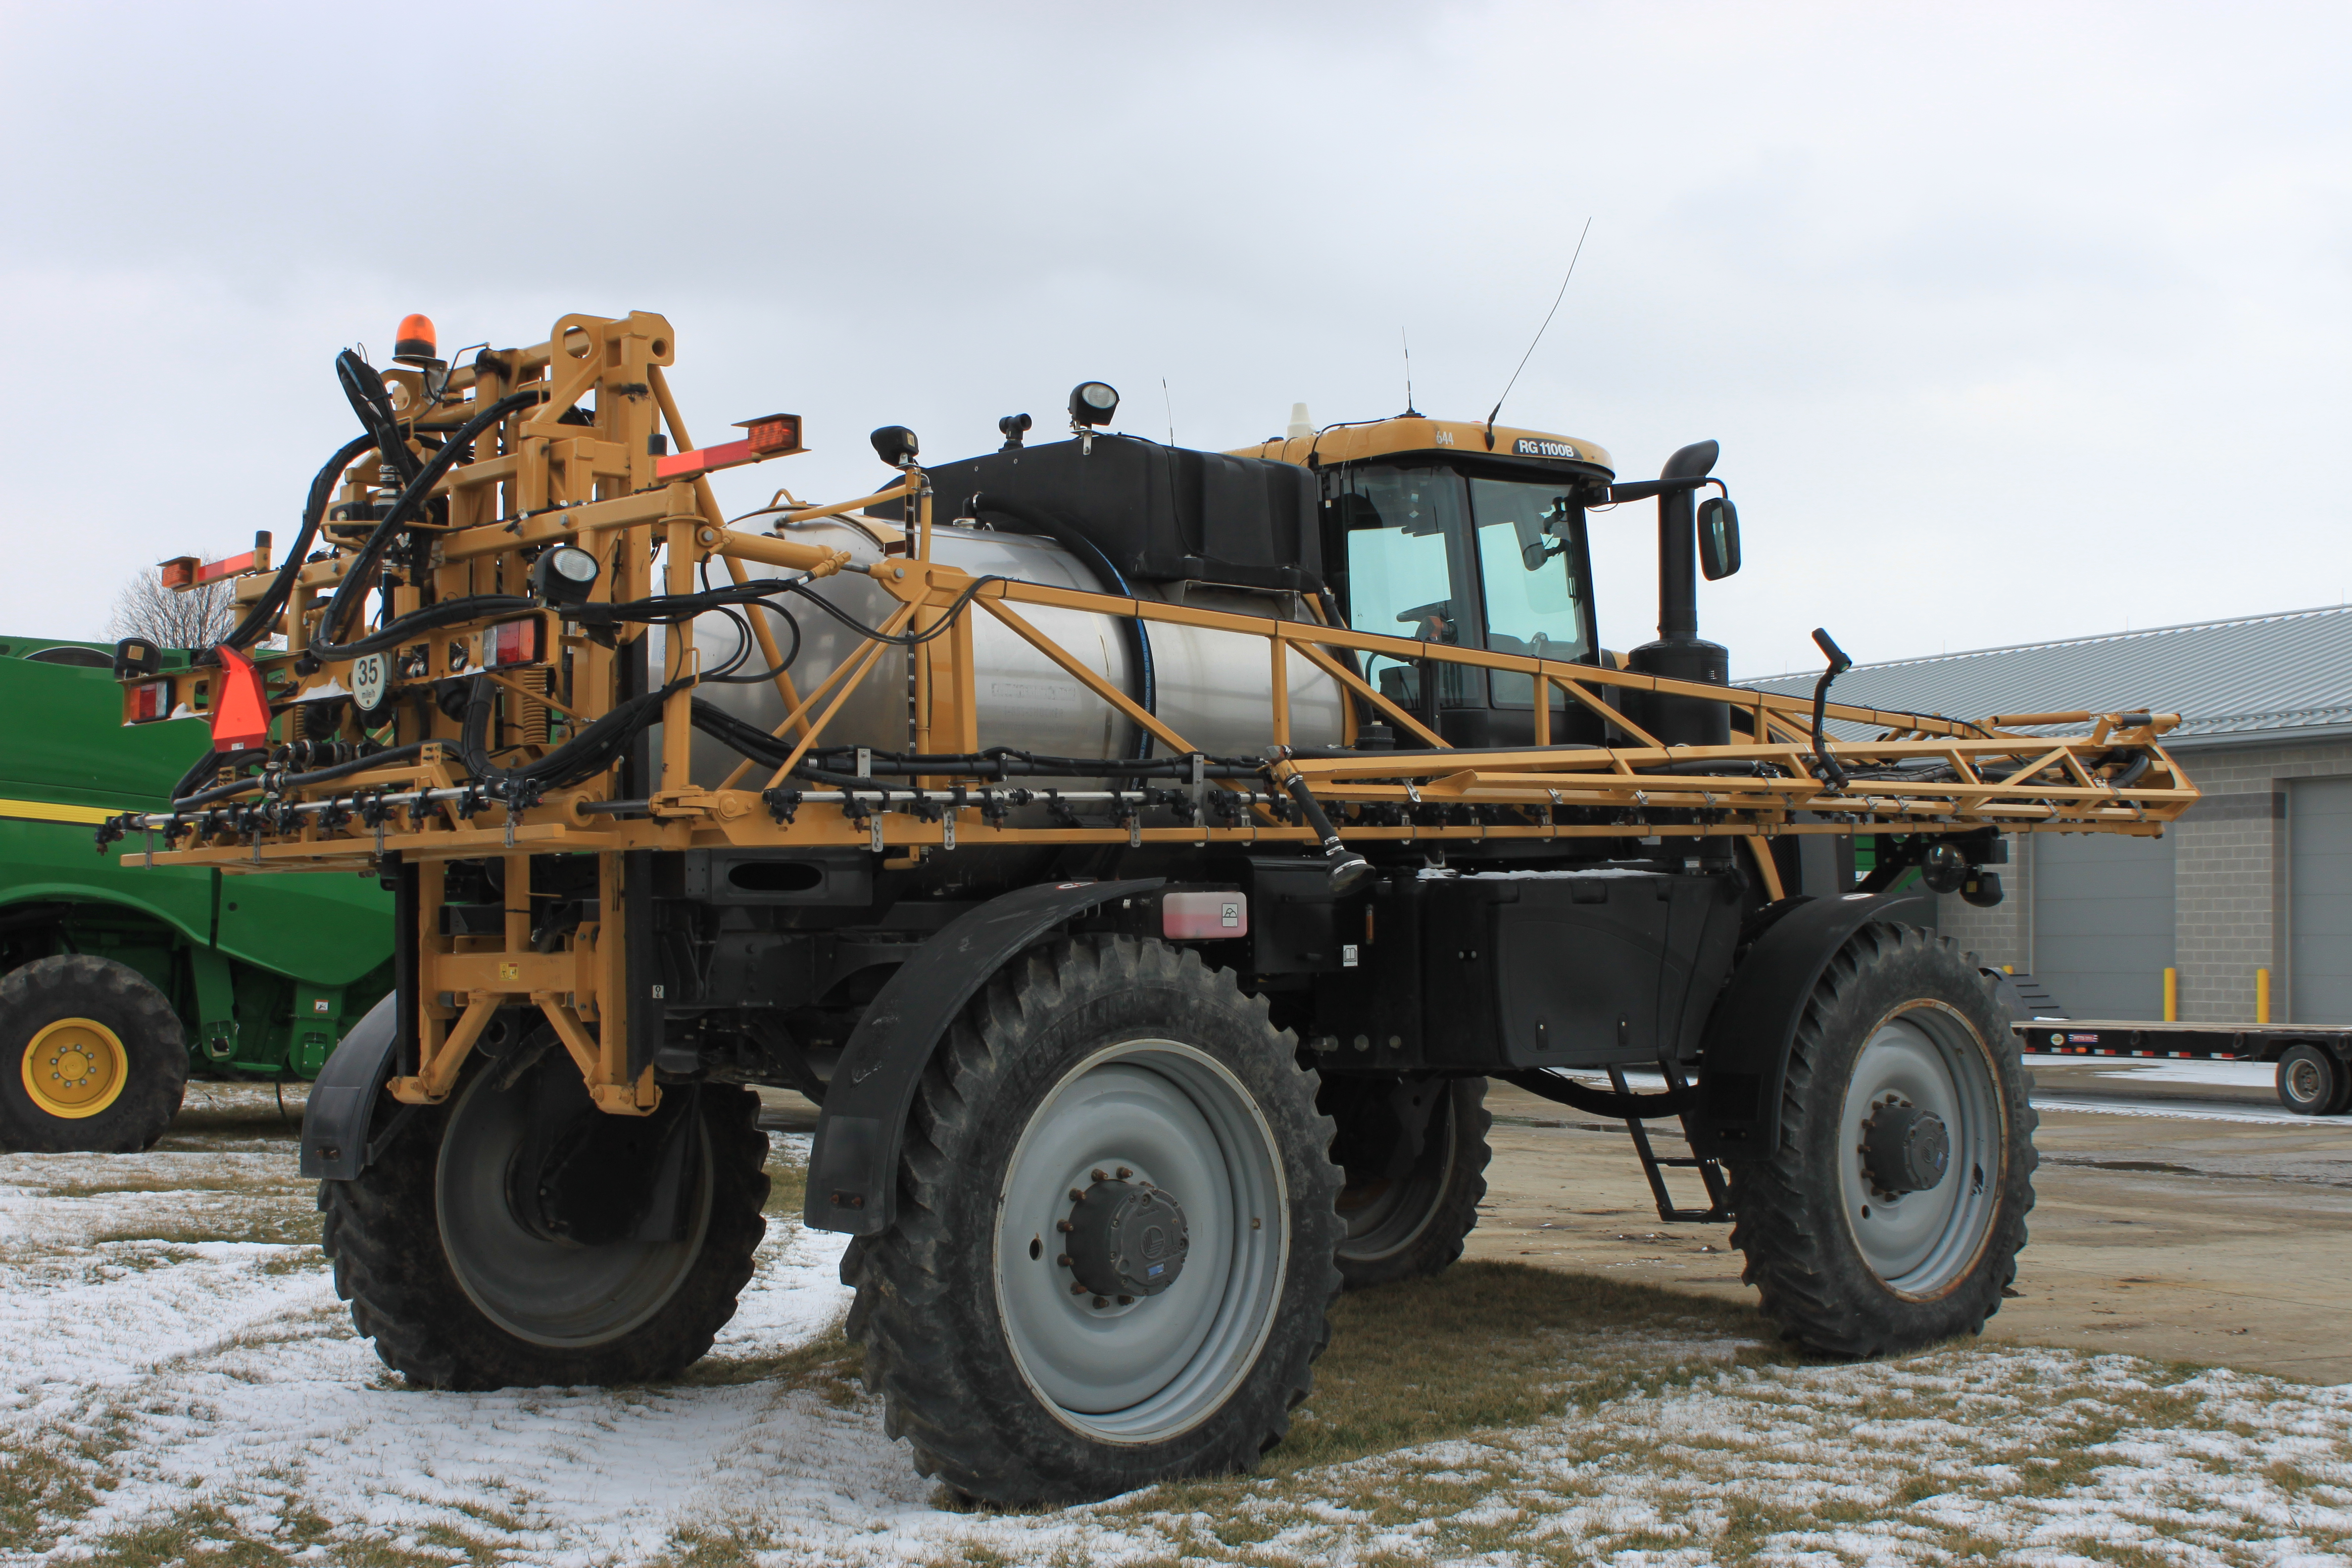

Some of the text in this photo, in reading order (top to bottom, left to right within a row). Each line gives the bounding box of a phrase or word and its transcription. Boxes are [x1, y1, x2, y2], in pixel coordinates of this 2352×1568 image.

[1436, 431, 1454, 445] 644
[1519, 440, 1574, 457] RG 1100B
[359, 658, 378, 686] 35
